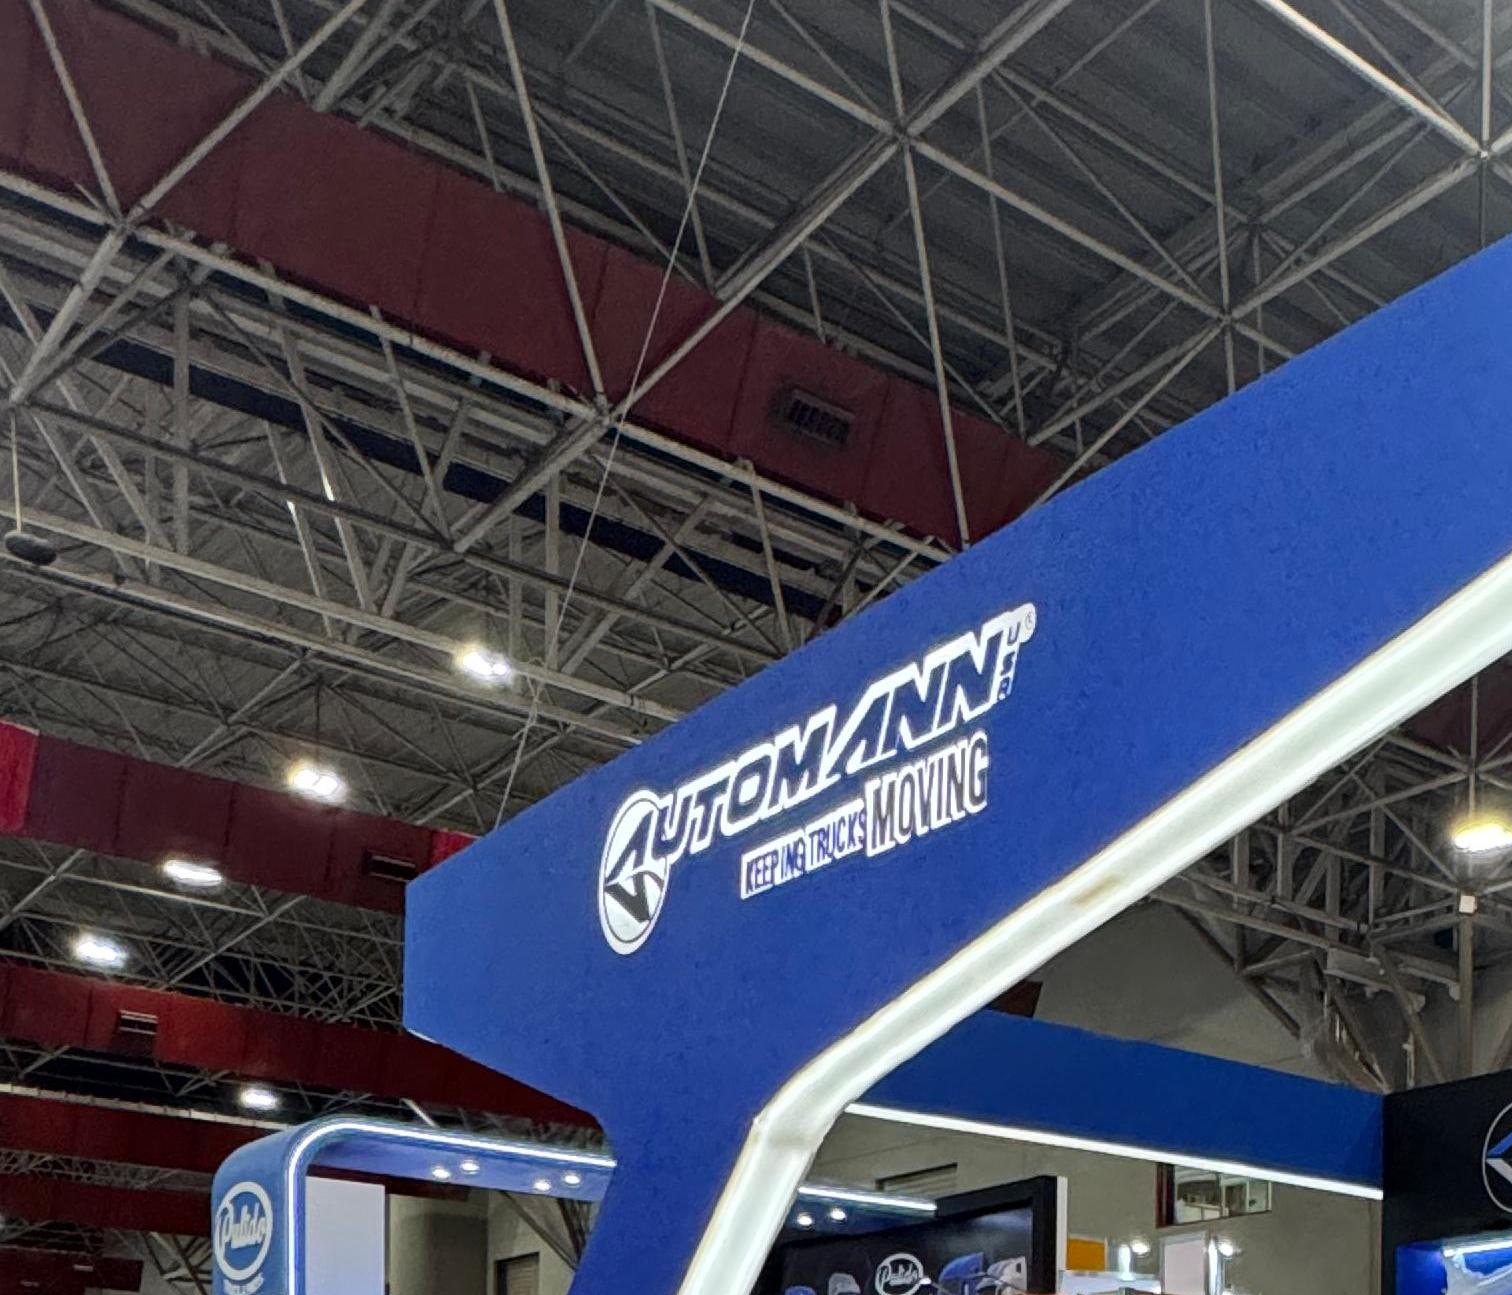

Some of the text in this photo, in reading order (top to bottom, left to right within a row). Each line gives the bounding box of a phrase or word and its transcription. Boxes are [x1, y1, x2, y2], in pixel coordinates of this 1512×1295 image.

[602, 618, 1006, 886] AUTOMANN
[744, 733, 989, 896] KEEPING TRUCKS MOVING
